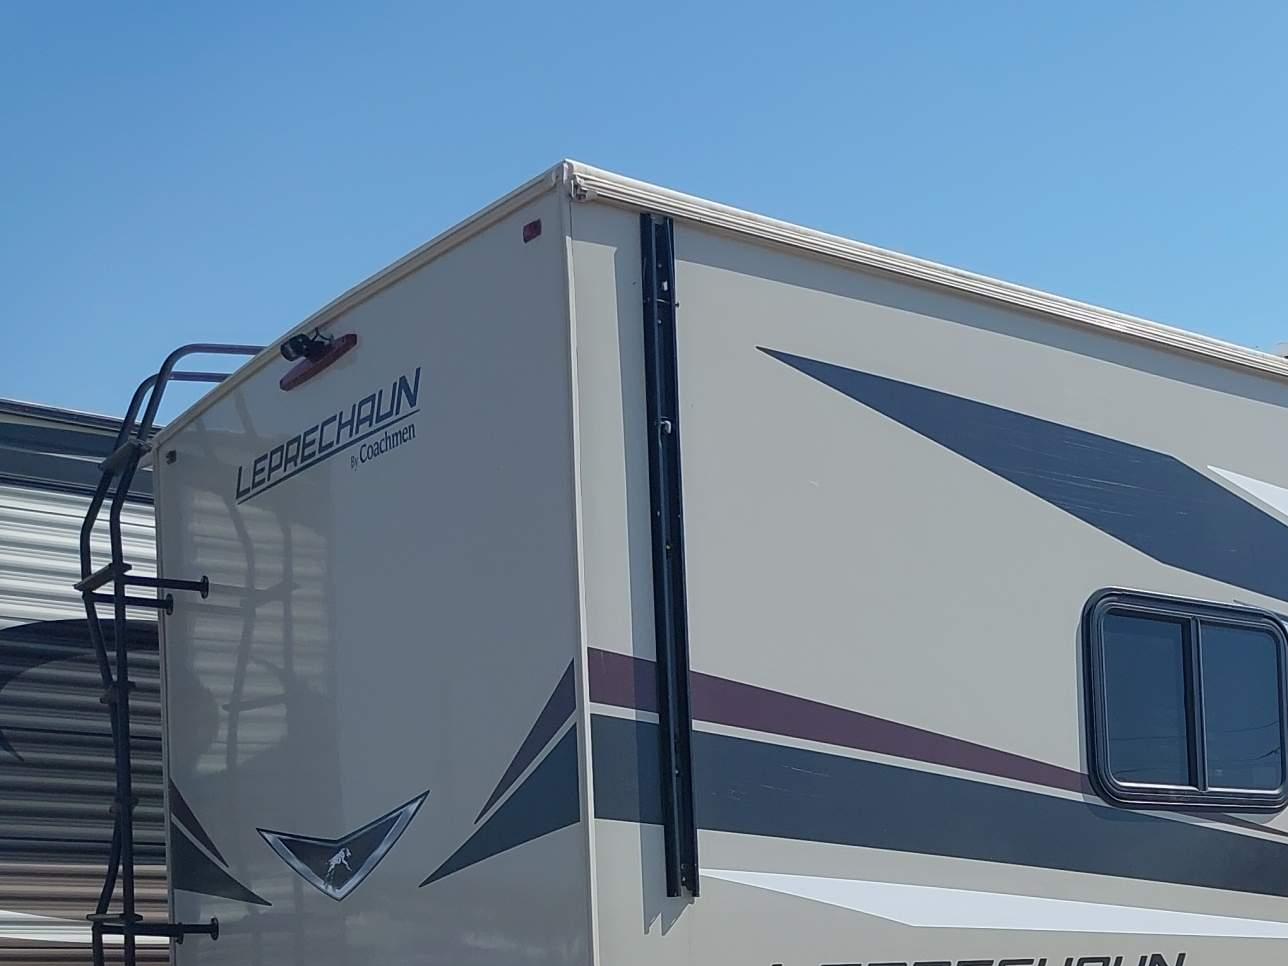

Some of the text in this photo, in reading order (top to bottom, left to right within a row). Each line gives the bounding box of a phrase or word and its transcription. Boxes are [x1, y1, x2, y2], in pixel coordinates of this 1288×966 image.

[235, 366, 421, 500] LEPRECHAUN
[350, 423, 416, 472] By Coachmen
